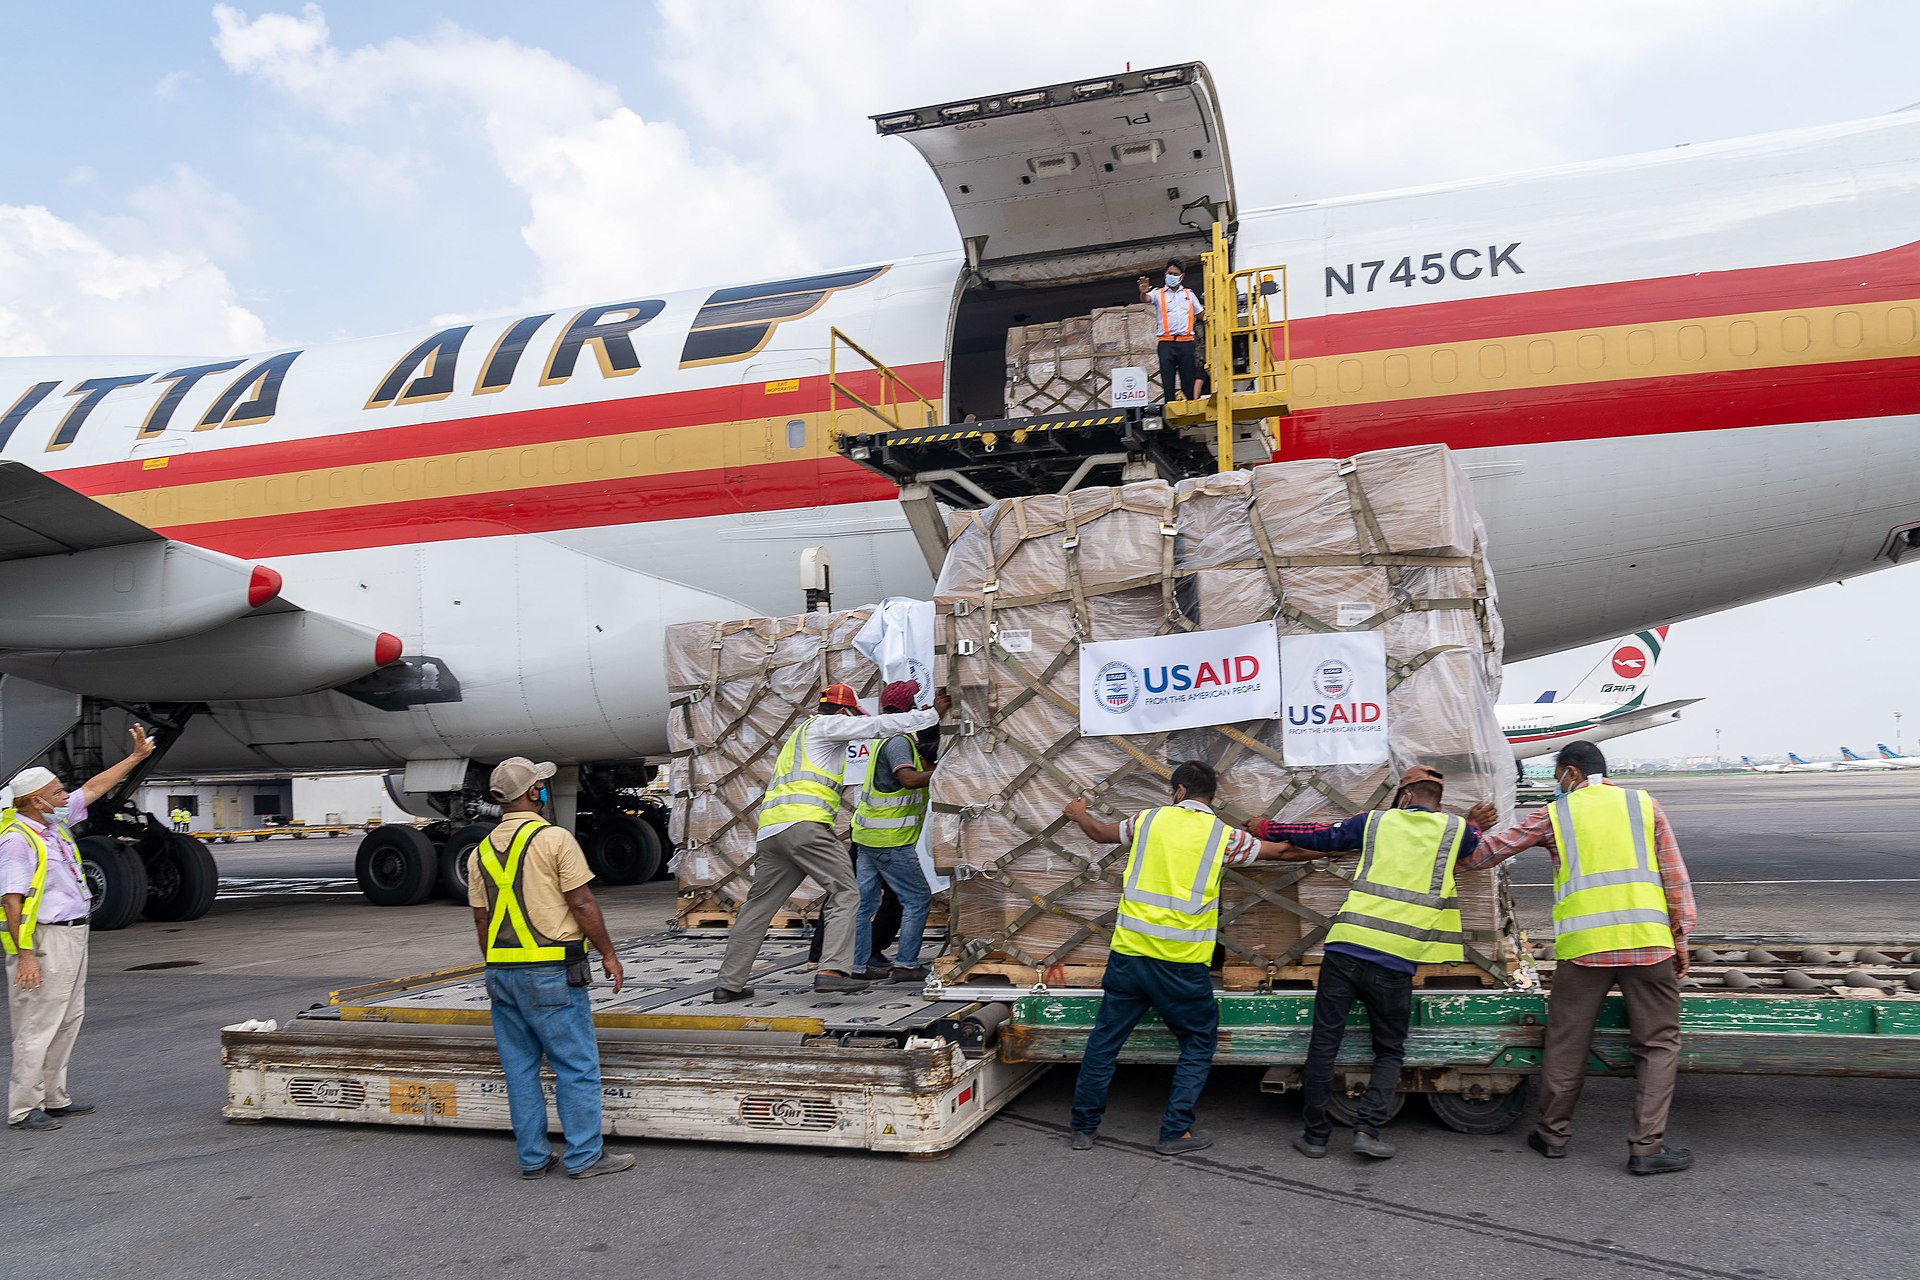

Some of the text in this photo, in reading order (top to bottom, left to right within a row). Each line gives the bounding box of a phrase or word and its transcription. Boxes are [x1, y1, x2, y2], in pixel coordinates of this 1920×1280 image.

[1112, 112, 1151, 126] PL
[1325, 242, 1525, 297] N745CK
[363, 299, 666, 410] AIR
[1114, 390, 1146, 400] USAID
[1143, 655, 1260, 693] USAID
[1144, 683, 1262, 705] FROM THE AMERICAN PEOPLE
[1288, 702, 1381, 726] USAID
